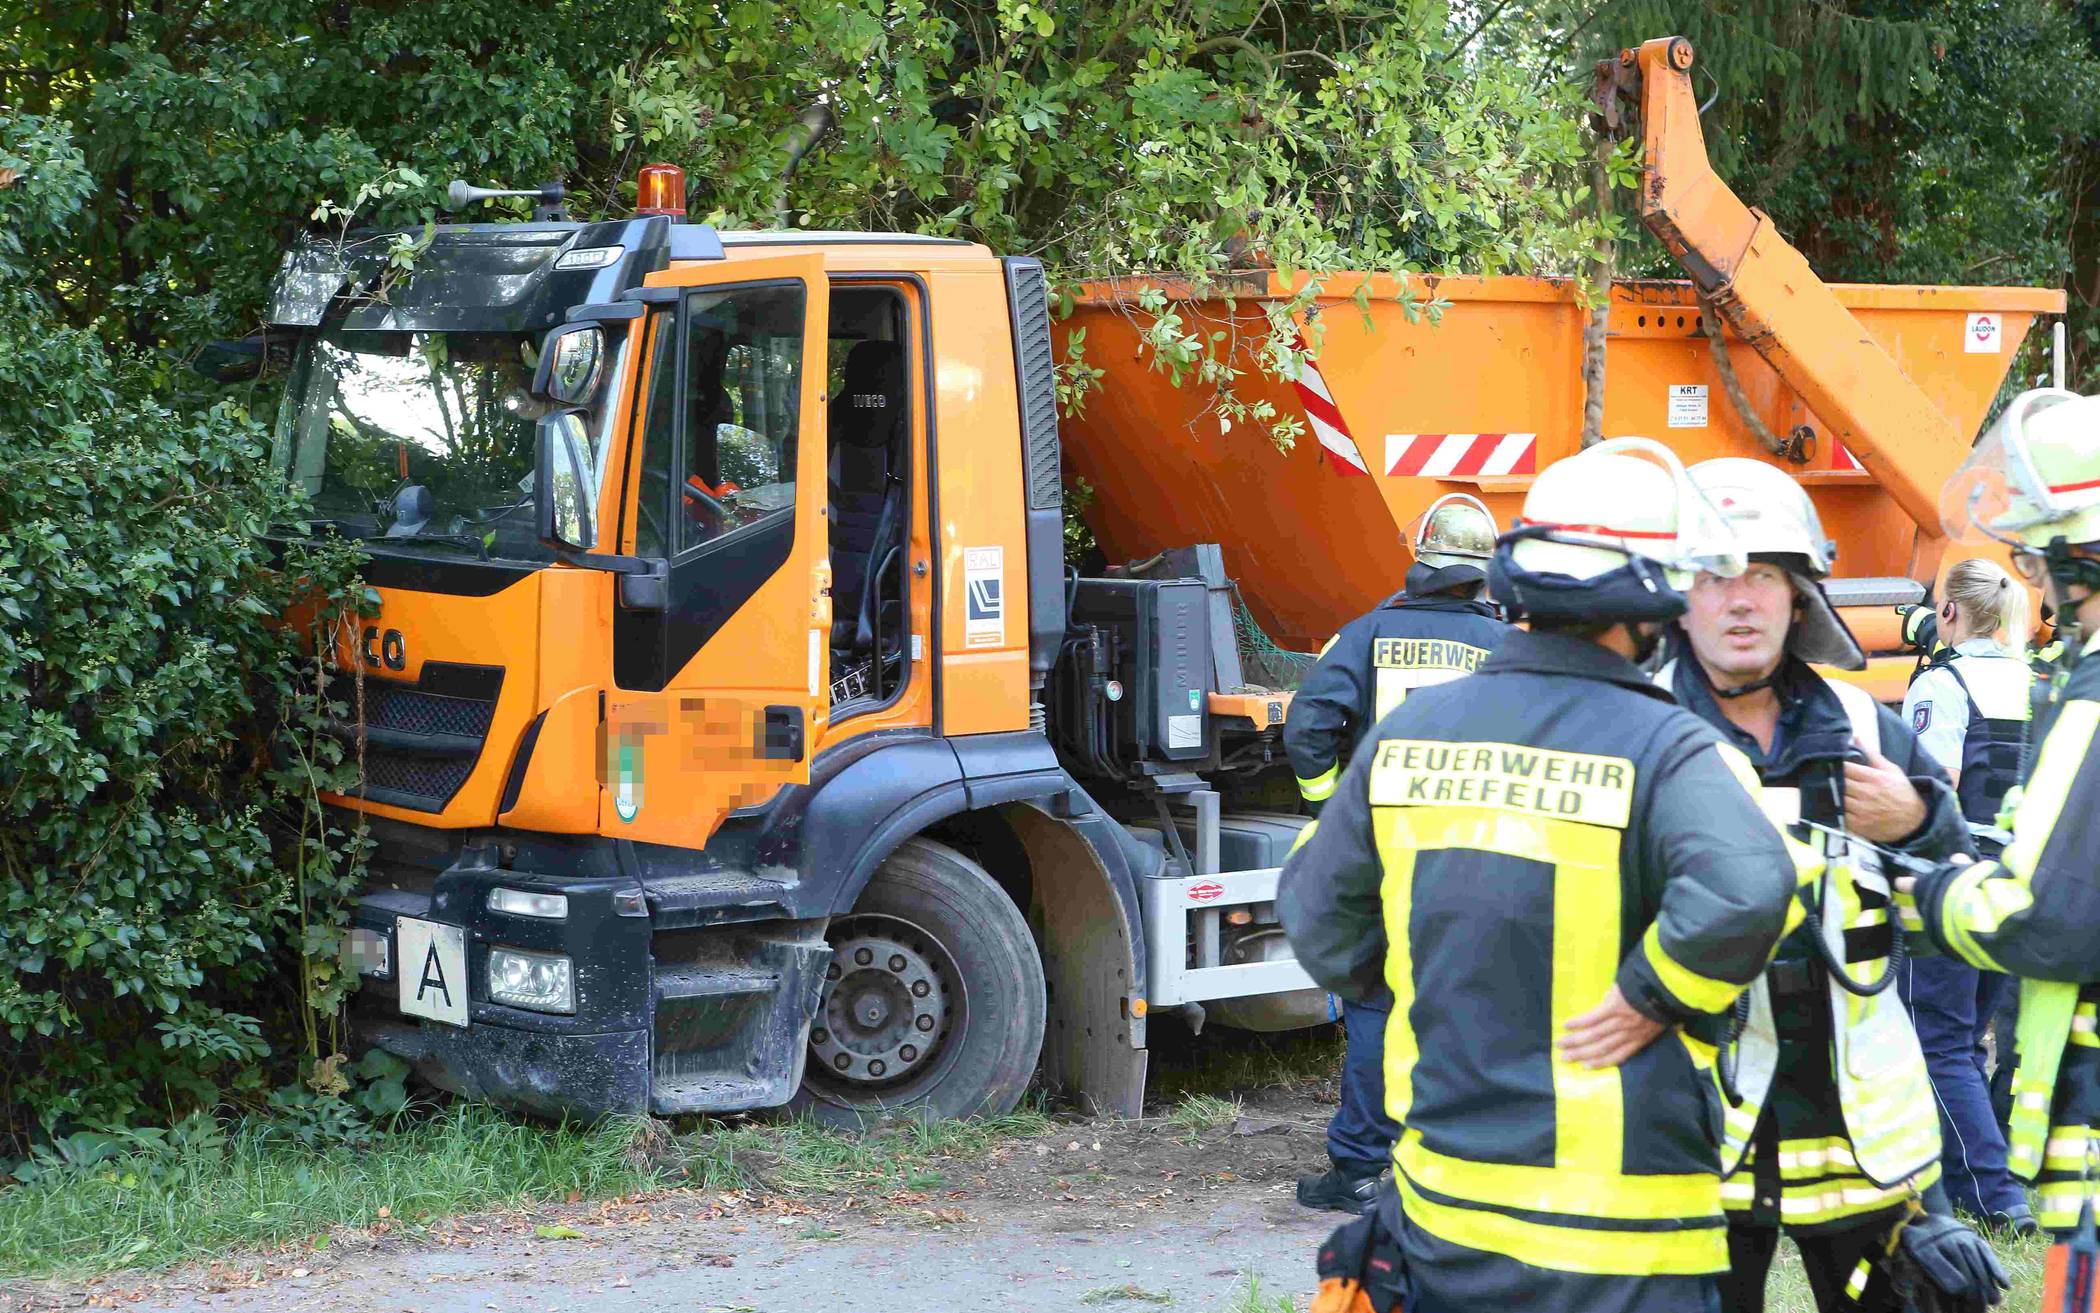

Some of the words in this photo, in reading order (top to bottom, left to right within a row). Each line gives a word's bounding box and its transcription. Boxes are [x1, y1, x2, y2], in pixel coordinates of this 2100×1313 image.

[1680, 386, 1697, 395] KRT
[1377, 640, 1488, 672] FEUERWEH
[1381, 745, 1625, 789] FEUERWEHR
[1407, 776, 1583, 815] KREFELD
[416, 932, 453, 1008] A
